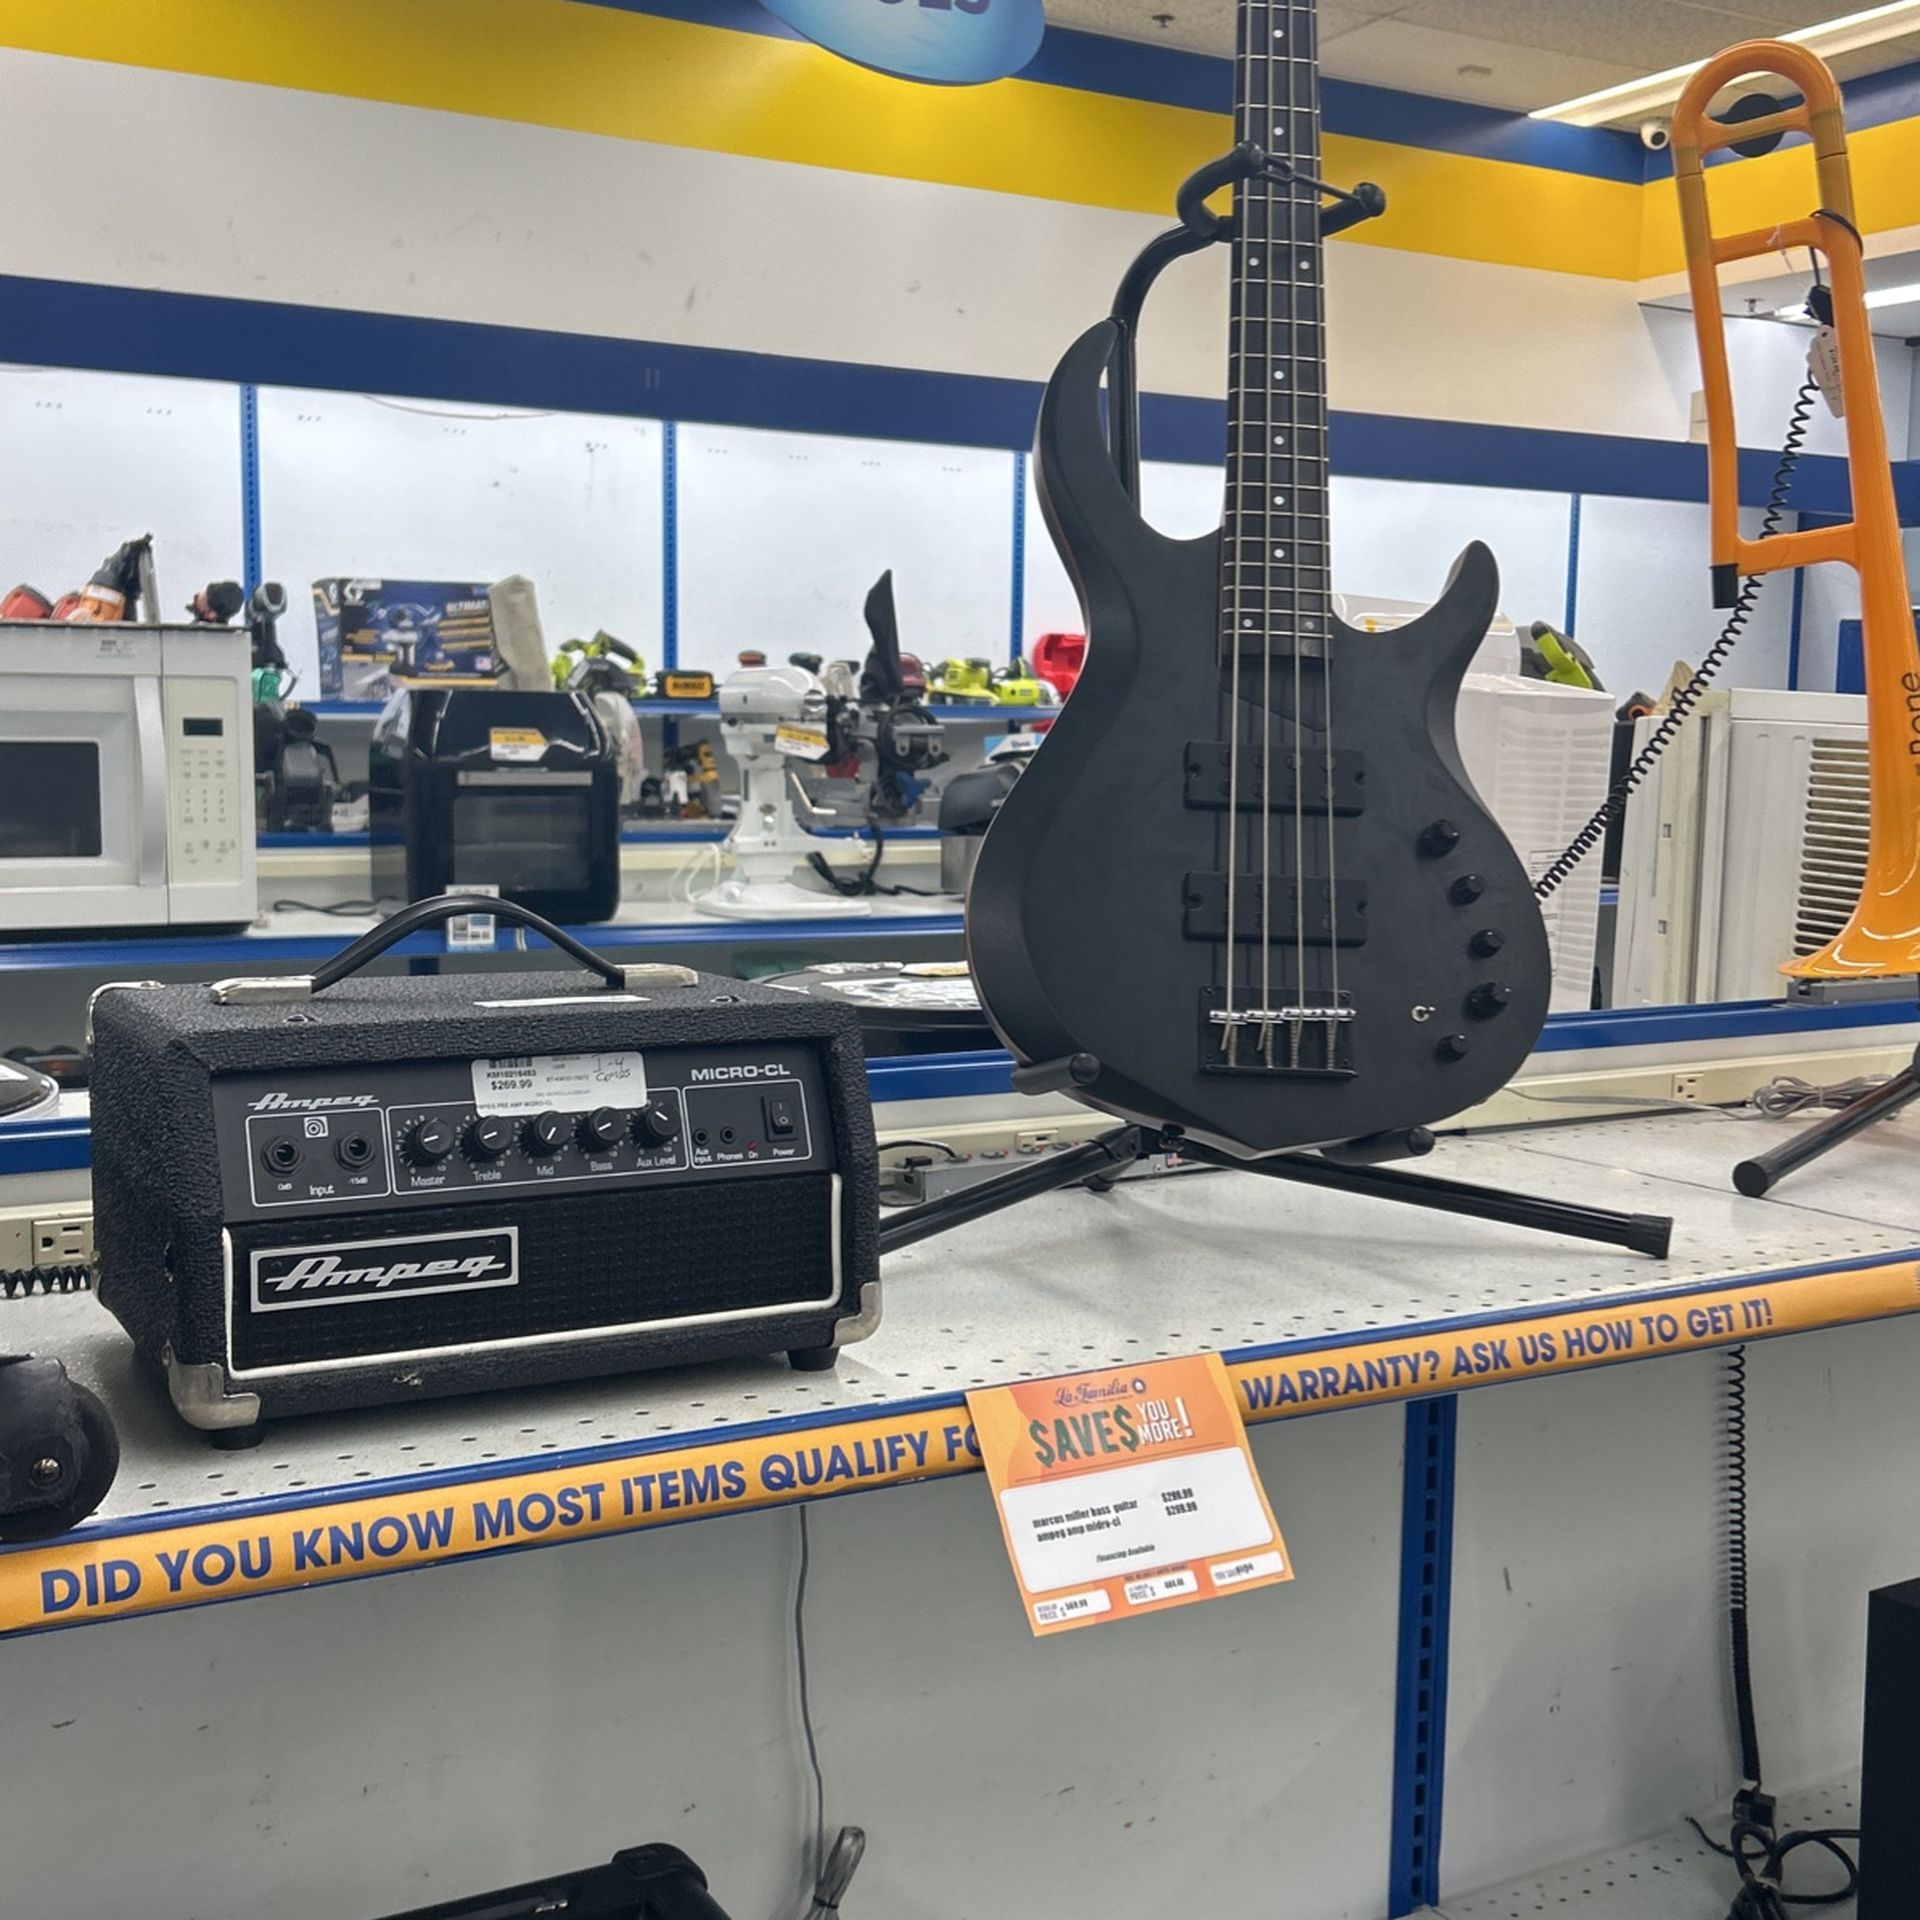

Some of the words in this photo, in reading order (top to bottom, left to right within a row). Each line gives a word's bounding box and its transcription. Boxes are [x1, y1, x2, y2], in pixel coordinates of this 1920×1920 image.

[691, 1064, 791, 1081] MICRO-CL
[491, 1079, 533, 1091] $269.99
[247, 1092, 380, 1110] Ampeg
[717, 1151, 743, 1161] Phones
[773, 1147, 795, 1157] Power
[590, 1161, 613, 1172] Bass
[636, 1157, 653, 1168] Aux
[654, 1154, 677, 1166] Level
[473, 1170, 502, 1182] Treble
[536, 1165, 555, 1176] Mid
[411, 1175, 446, 1187] Master
[309, 1184, 335, 1197] Input
[265, 1255, 506, 1292] Ampeg
[1240, 1350, 1440, 1411] WARRANTY?
[1451, 1338, 1511, 1378] ASK
[1516, 1331, 1557, 1366] US
[1562, 1319, 1633, 1359] HOW
[1639, 1313, 1678, 1345] TO
[1687, 1303, 1734, 1338] GET
[1740, 1297, 1773, 1330] IT!
[1136, 1398, 1170, 1423] YOU
[1032, 1513, 1065, 1529] marcus
[1065, 1509, 1090, 1523] miller
[1091, 1504, 1111, 1517] bass
[1113, 1500, 1138, 1514] guitar
[41, 1559, 142, 1614] DID
[156, 1536, 272, 1592] YOU
[293, 1506, 454, 1572] KNOW
[473, 1483, 605, 1541] MOST
[620, 1460, 747, 1516] ITEMS
[760, 1430, 929, 1493] QUALIFY
[1036, 1527, 1066, 1542] ampeg
[1066, 1524, 1085, 1537] amp
